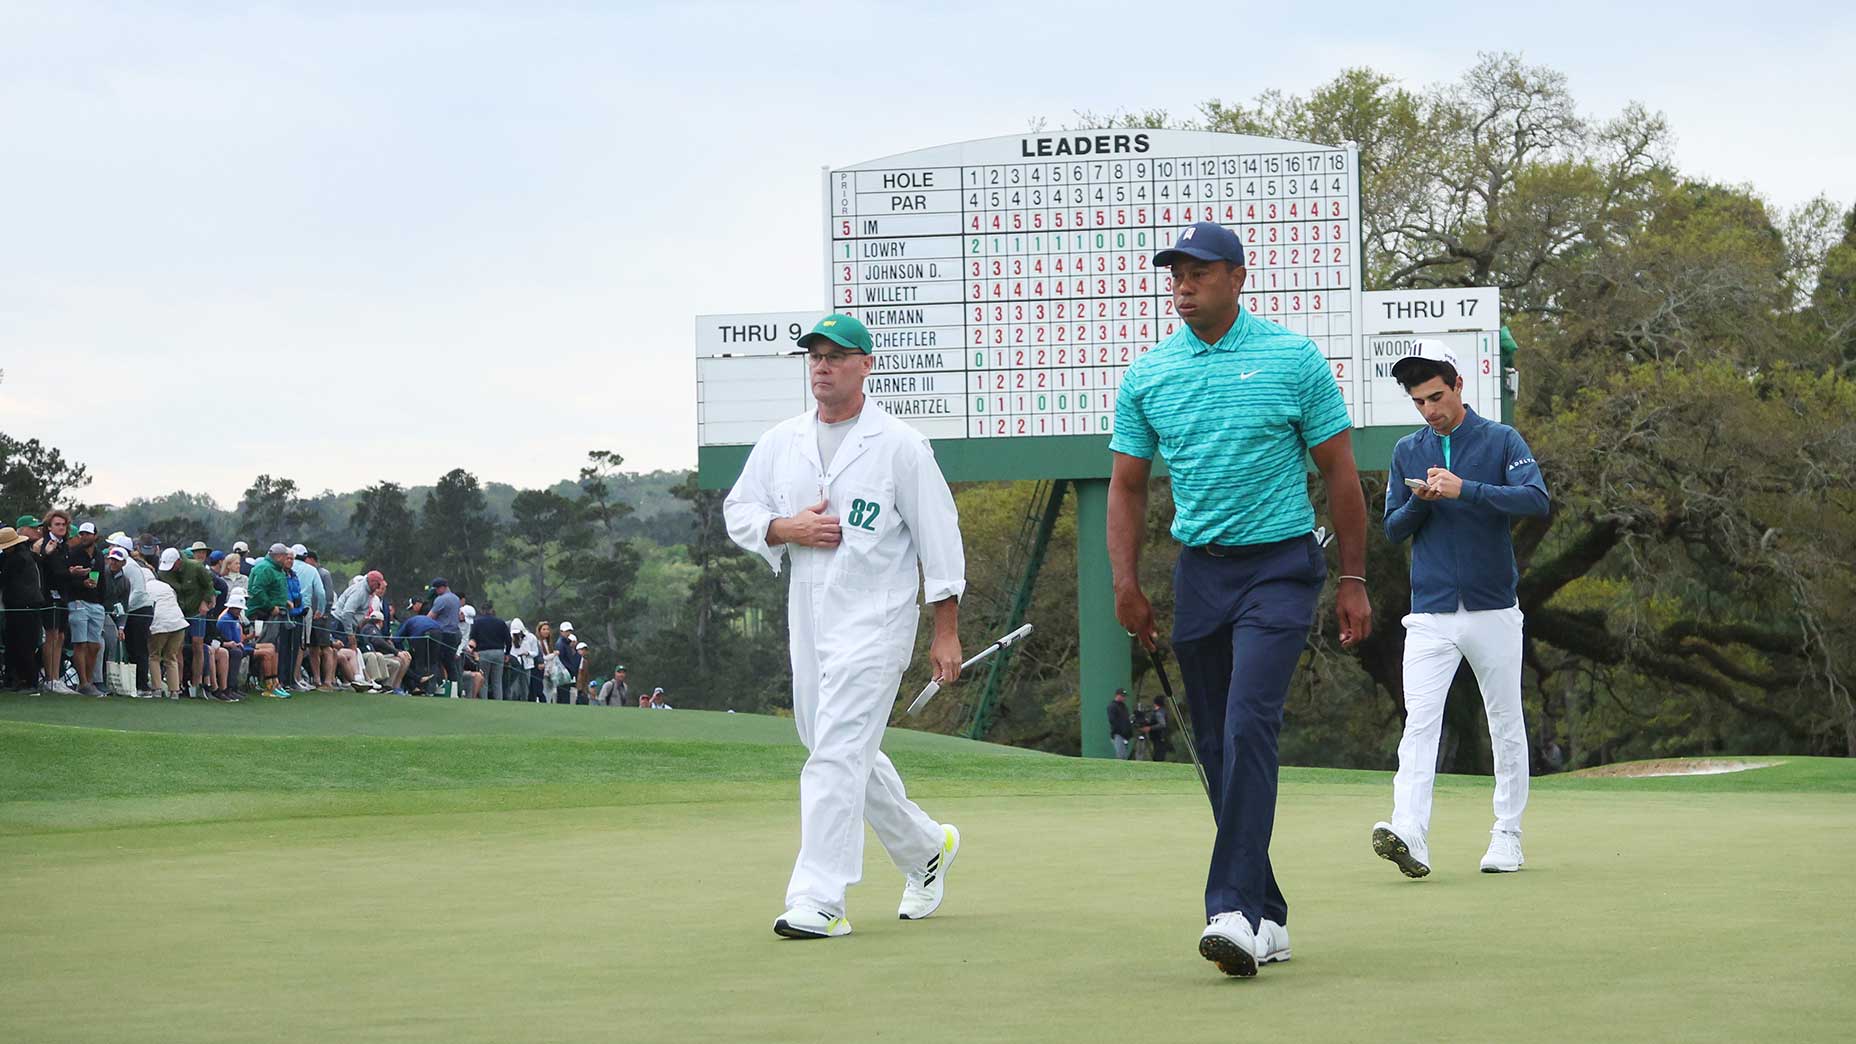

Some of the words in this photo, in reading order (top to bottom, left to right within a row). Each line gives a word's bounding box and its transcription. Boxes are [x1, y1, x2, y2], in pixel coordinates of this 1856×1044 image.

[1022, 134, 1150, 157] LEADERS
[883, 172, 934, 189] HOLE
[971, 171, 976, 185] 1
[991, 169, 999, 184] 2
[1011, 168, 1020, 184] 3
[1032, 168, 1040, 182] 4
[1053, 167, 1061, 182] 5
[1073, 165, 1082, 181] 6
[1094, 165, 1102, 180] 7
[1114, 164, 1123, 179] 8
[1137, 163, 1146, 178] 9
[1157, 162, 1173, 177] 10
[1181, 161, 1192, 176] 11
[1201, 160, 1215, 176] 12
[1222, 159, 1236, 175] 13
[1242, 159, 1257, 174] 14
[1264, 158, 1279, 173] 15
[1285, 156, 1300, 172] 16
[1307, 156, 1320, 171] 17
[1329, 154, 1344, 170] 18
[841, 173, 849, 215] PRIOR
[892, 195, 927, 211] PAR
[970, 193, 978, 207] 4
[991, 192, 1000, 207] 5
[1012, 191, 1021, 206] 4
[1033, 190, 1041, 205] 3
[1053, 189, 1062, 204] 4
[1075, 188, 1083, 204] 3
[1095, 188, 1104, 202] 4
[1116, 186, 1125, 202] 5
[1137, 186, 1146, 200] 4
[1161, 185, 1170, 199] 4
[1182, 184, 1191, 198] 4
[1205, 183, 1213, 198] 3
[1226, 182, 1234, 197] 5
[1246, 181, 1255, 196] 4
[1268, 180, 1276, 196] 5
[1289, 179, 1297, 195] 3
[1310, 179, 1319, 193] 4
[1332, 178, 1341, 192] 4
[842, 221, 851, 236] 5
[864, 220, 878, 235] IM
[971, 216, 979, 230] 4
[992, 215, 1000, 230] 4
[1013, 214, 1021, 229] 5
[1034, 213, 1042, 229] 5
[1055, 212, 1063, 228] 5
[1076, 211, 1083, 227] 5
[1096, 211, 1104, 226] 5
[1118, 210, 1125, 225] 5
[1138, 209, 1146, 224] 5
[1162, 208, 1171, 223] 4
[1184, 207, 1192, 222] 4
[1205, 206, 1213, 222] 3
[1225, 205, 1233, 220] 4
[1247, 204, 1255, 220] 4
[1269, 204, 1276, 219] 3
[1290, 203, 1297, 218] 4
[1311, 202, 1319, 217] 4
[1332, 201, 1340, 217] 3
[844, 244, 850, 258] 1
[864, 242, 906, 258] LOWRY
[972, 238, 980, 254] 2
[1096, 233, 1104, 249] 0
[1117, 233, 1125, 248] 0
[1138, 232, 1146, 247] 0
[1248, 227, 1256, 243] 2
[1269, 227, 1277, 243] 3
[1291, 226, 1299, 242] 3
[1312, 225, 1320, 241] 3
[1333, 224, 1341, 240] 3
[843, 266, 851, 281] 3
[865, 264, 924, 281] JOHNSON
[930, 263, 941, 278] D.
[972, 262, 980, 277] 3
[993, 260, 1001, 276] 3
[1014, 260, 1021, 275] 3
[1035, 259, 1042, 274] 4
[1055, 258, 1063, 273] 4
[1076, 257, 1083, 272] 4
[1098, 257, 1105, 272] 3
[1118, 256, 1126, 271] 3
[1139, 255, 1146, 270] 2
[1249, 251, 1256, 266] 2
[1269, 250, 1277, 265] 2
[1291, 249, 1299, 264] 2
[1313, 248, 1320, 263] 2
[1333, 247, 1341, 263] 2
[844, 289, 852, 304] 3
[865, 286, 918, 302] WILLETT
[973, 284, 981, 299] 3
[993, 283, 1001, 298] 4
[1014, 282, 1022, 297] 4
[1034, 281, 1043, 296] 4
[1055, 281, 1063, 296] 4
[1076, 280, 1084, 295] 4
[1098, 279, 1106, 294] 3
[1118, 278, 1126, 294] 3
[1139, 277, 1147, 292] 4
[866, 309, 924, 325] NIEMANN
[975, 307, 982, 322] 3
[995, 306, 1002, 321] 3
[1015, 305, 1023, 320] 3
[1036, 304, 1044, 320] 3
[1057, 303, 1065, 319] 2
[1077, 303, 1085, 318] 2
[1098, 302, 1106, 317] 2
[1119, 301, 1127, 317] 2
[1140, 301, 1148, 316] 2
[1250, 297, 1257, 312] 3
[1271, 296, 1279, 312] 3
[1293, 295, 1300, 311] 3
[1313, 294, 1321, 310] 3
[1382, 300, 1444, 319] THRU
[1457, 299, 1478, 317] 17
[718, 324, 777, 343] THRU
[789, 323, 802, 340] 9
[974, 329, 982, 344] 2
[995, 329, 1003, 344] 3
[1016, 328, 1023, 343] 2
[1037, 327, 1045, 342] 2
[1058, 326, 1065, 342] 2
[1077, 325, 1086, 341] 2
[1099, 325, 1107, 340] 3
[1119, 324, 1127, 339] 4
[1140, 324, 1148, 338] 4
[1483, 338, 1488, 353] 1
[975, 352, 983, 367] 0
[1016, 350, 1024, 366] 2
[1038, 350, 1045, 365] 2
[1058, 349, 1066, 364] 2
[1078, 348, 1086, 364] 3
[1100, 347, 1107, 363] 2
[1121, 347, 1128, 362] 2
[1482, 360, 1490, 375] 3
[868, 377, 916, 393] VARNER
[922, 376, 934, 392] III
[997, 374, 1004, 389] 2
[1016, 373, 1024, 388] 2
[1038, 372, 1046, 388] 2
[976, 397, 984, 413] 0
[1038, 394, 1046, 411] 0
[1058, 394, 1067, 410] 0
[1079, 393, 1087, 409] 0
[848, 498, 881, 532] 82
